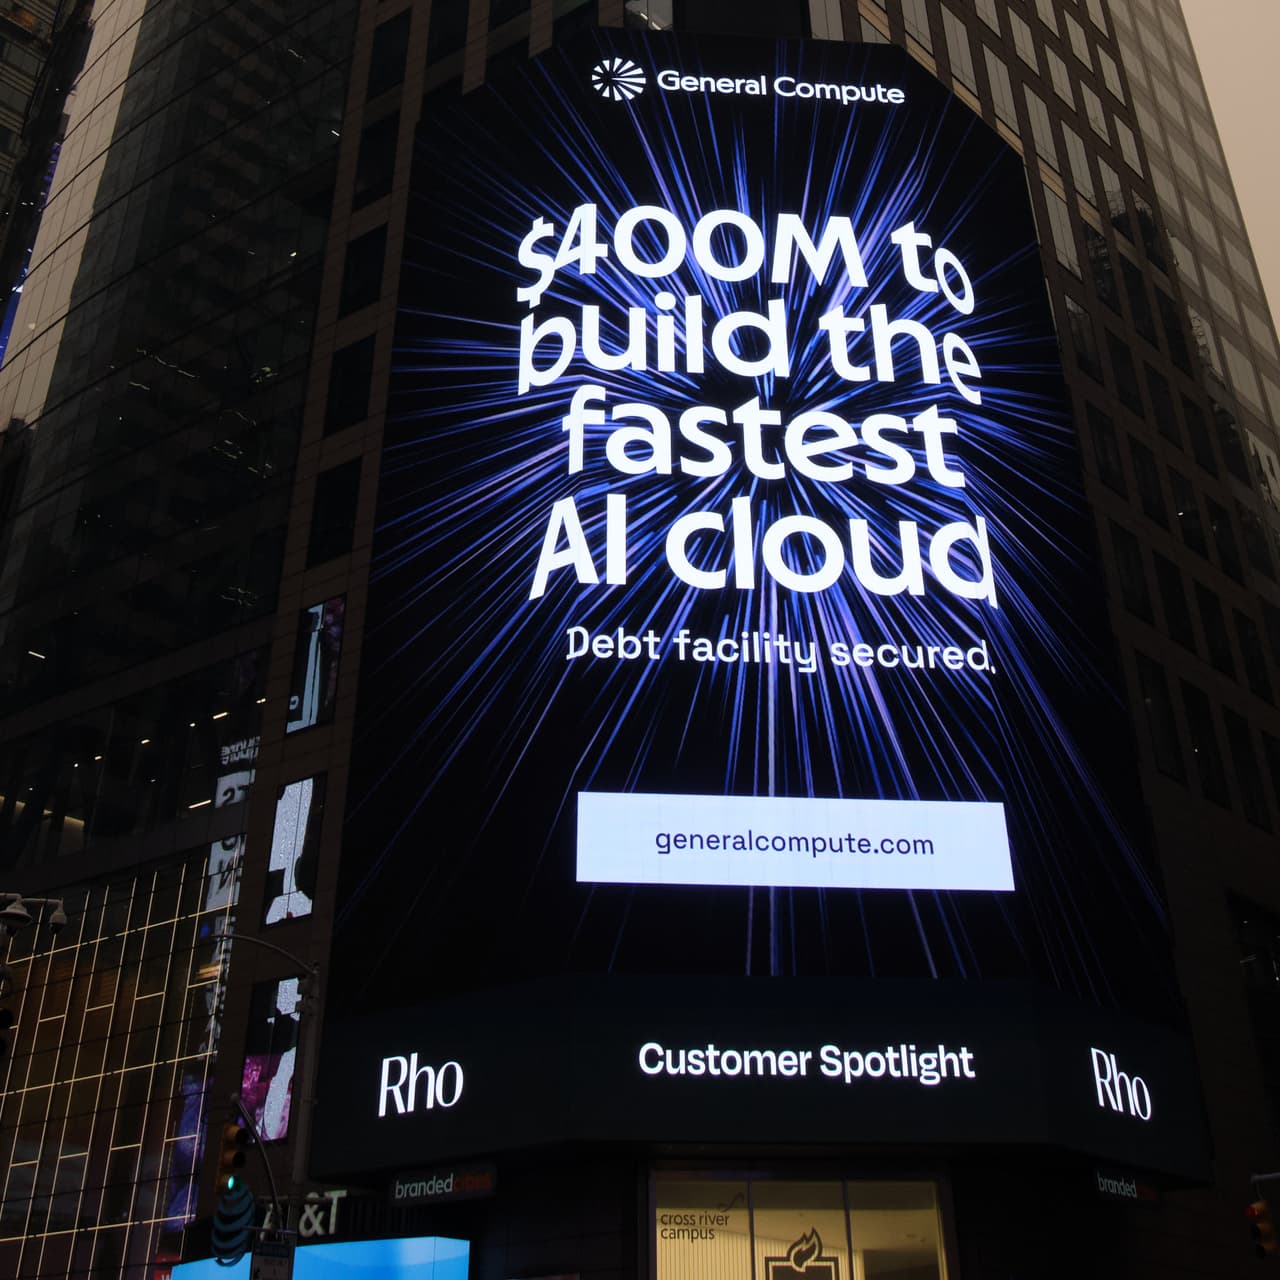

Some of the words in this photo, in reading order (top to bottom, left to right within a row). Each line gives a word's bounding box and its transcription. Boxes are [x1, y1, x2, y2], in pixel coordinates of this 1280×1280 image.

[656, 69, 767, 97] General
[773, 76, 905, 106] Compute
[516, 203, 869, 309] $400M
[891, 220, 976, 316] to
[517, 291, 791, 397] build
[819, 303, 982, 406] the
[562, 384, 967, 488] fastest
[528, 493, 628, 602] AI
[665, 494, 999, 609] cloud
[566, 626, 661, 661] Debt
[672, 628, 817, 674] facility
[830, 639, 997, 676] secured.
[655, 830, 935, 858] generalcompute.com
[378, 1052, 464, 1117] Rho
[639, 1042, 812, 1076] Customer
[820, 1043, 975, 1086] Spotlight
[1090, 1046, 1152, 1121] Rho
[259, 1189, 348, 1243] A&T
[660, 1213, 696, 1226] cross
[699, 1210, 730, 1226] river
[660, 1227, 716, 1243] campus
